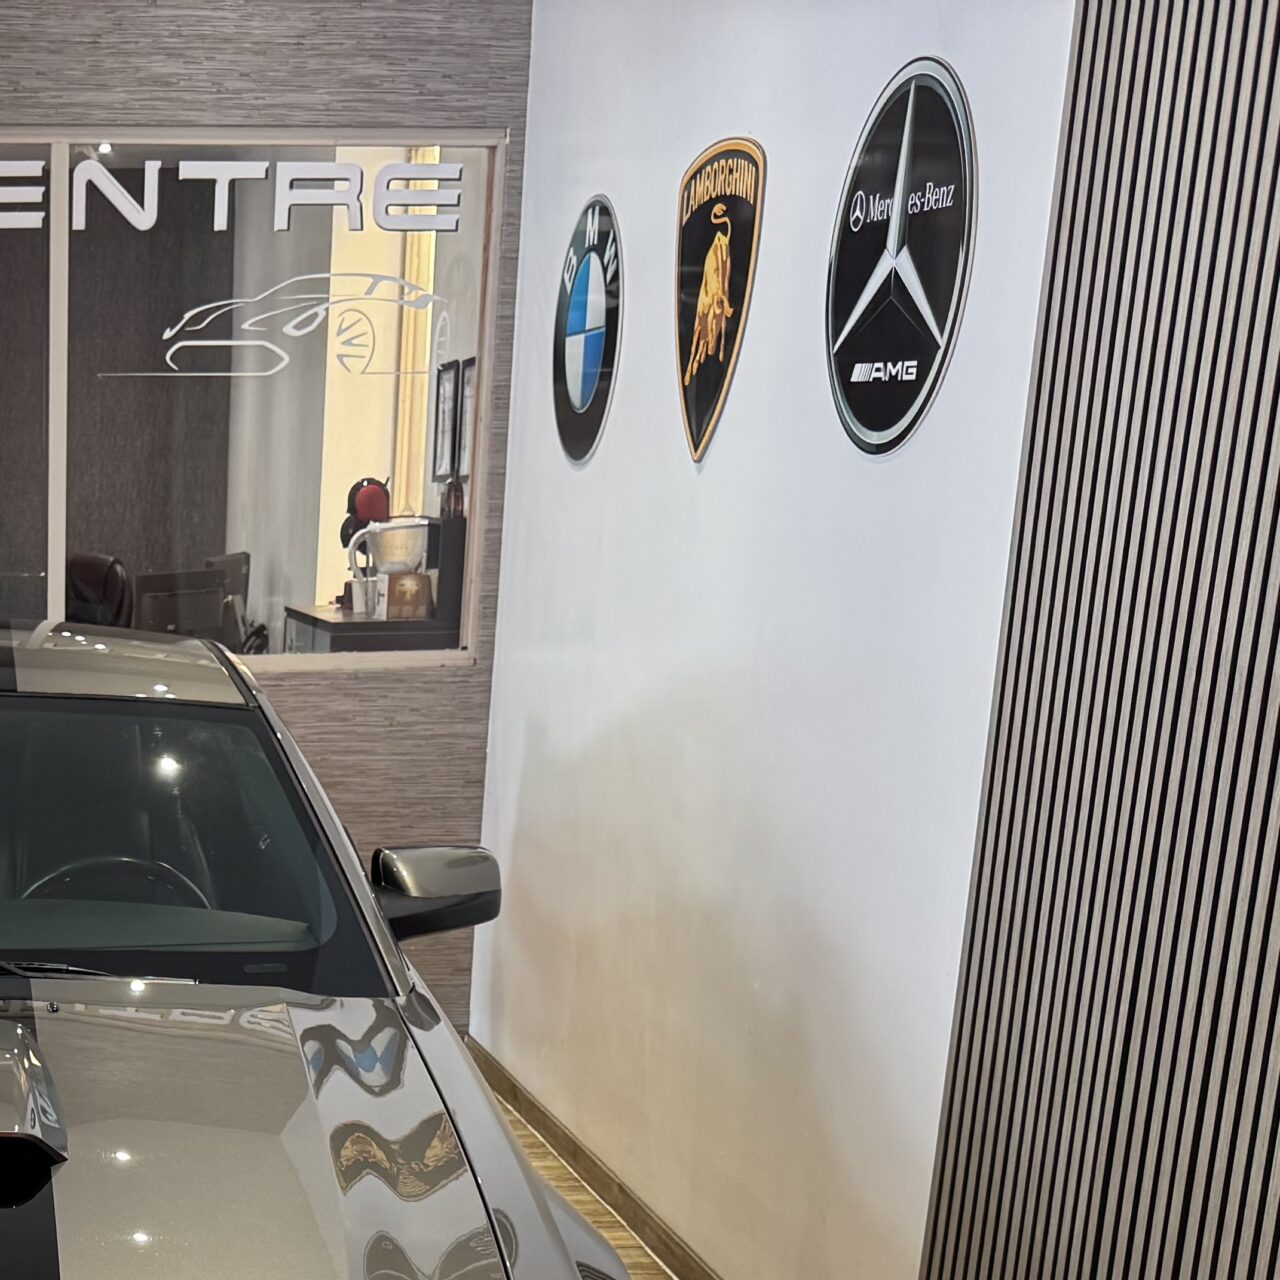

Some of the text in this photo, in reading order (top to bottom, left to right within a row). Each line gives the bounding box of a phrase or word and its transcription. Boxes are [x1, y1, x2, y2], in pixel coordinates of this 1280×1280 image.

[681, 156, 757, 227] LAMBORGHINI
[563, 206, 617, 294] BMW
[869, 360, 918, 382] AMG
